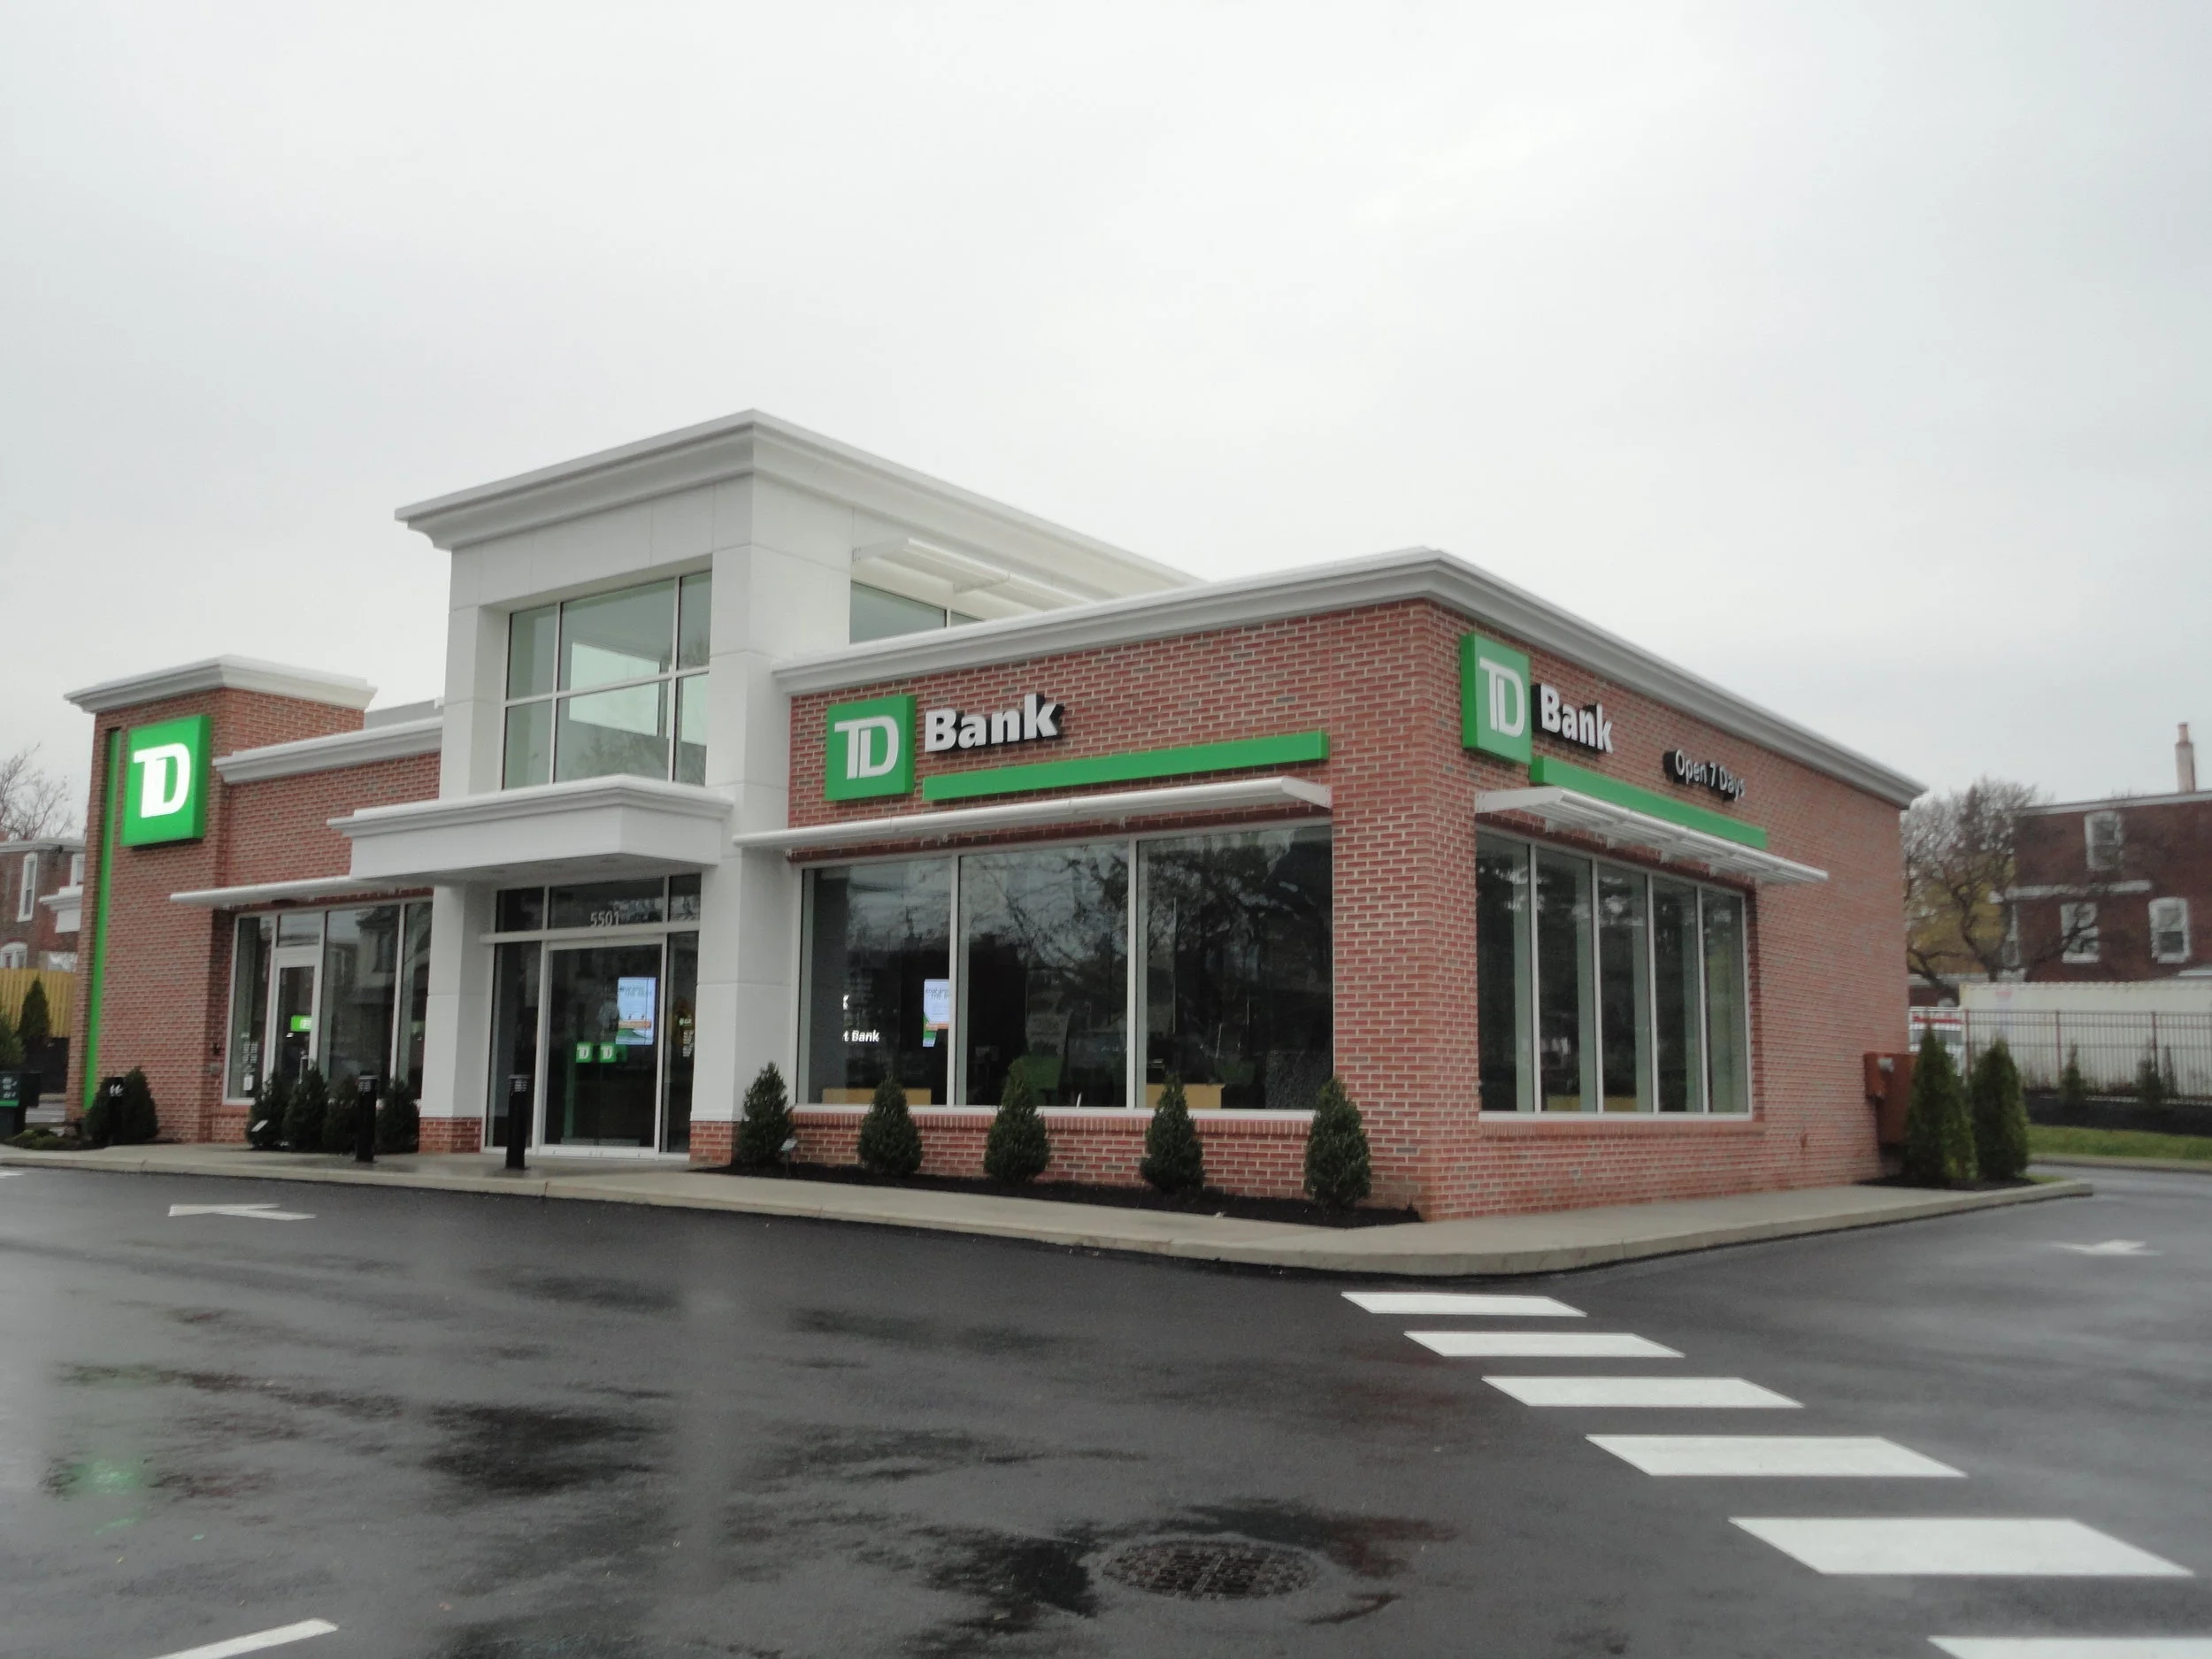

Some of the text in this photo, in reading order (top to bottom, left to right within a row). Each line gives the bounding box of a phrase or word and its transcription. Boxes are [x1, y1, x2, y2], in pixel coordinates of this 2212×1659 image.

[834, 693, 1058, 780] TD Bank
[1479, 657, 1614, 754] TD Bank
[133, 742, 190, 818] TD
[1675, 749, 1746, 802] Open 7 Days
[590, 910, 620, 927] 5501
[851, 1029, 879, 1042] Bank
